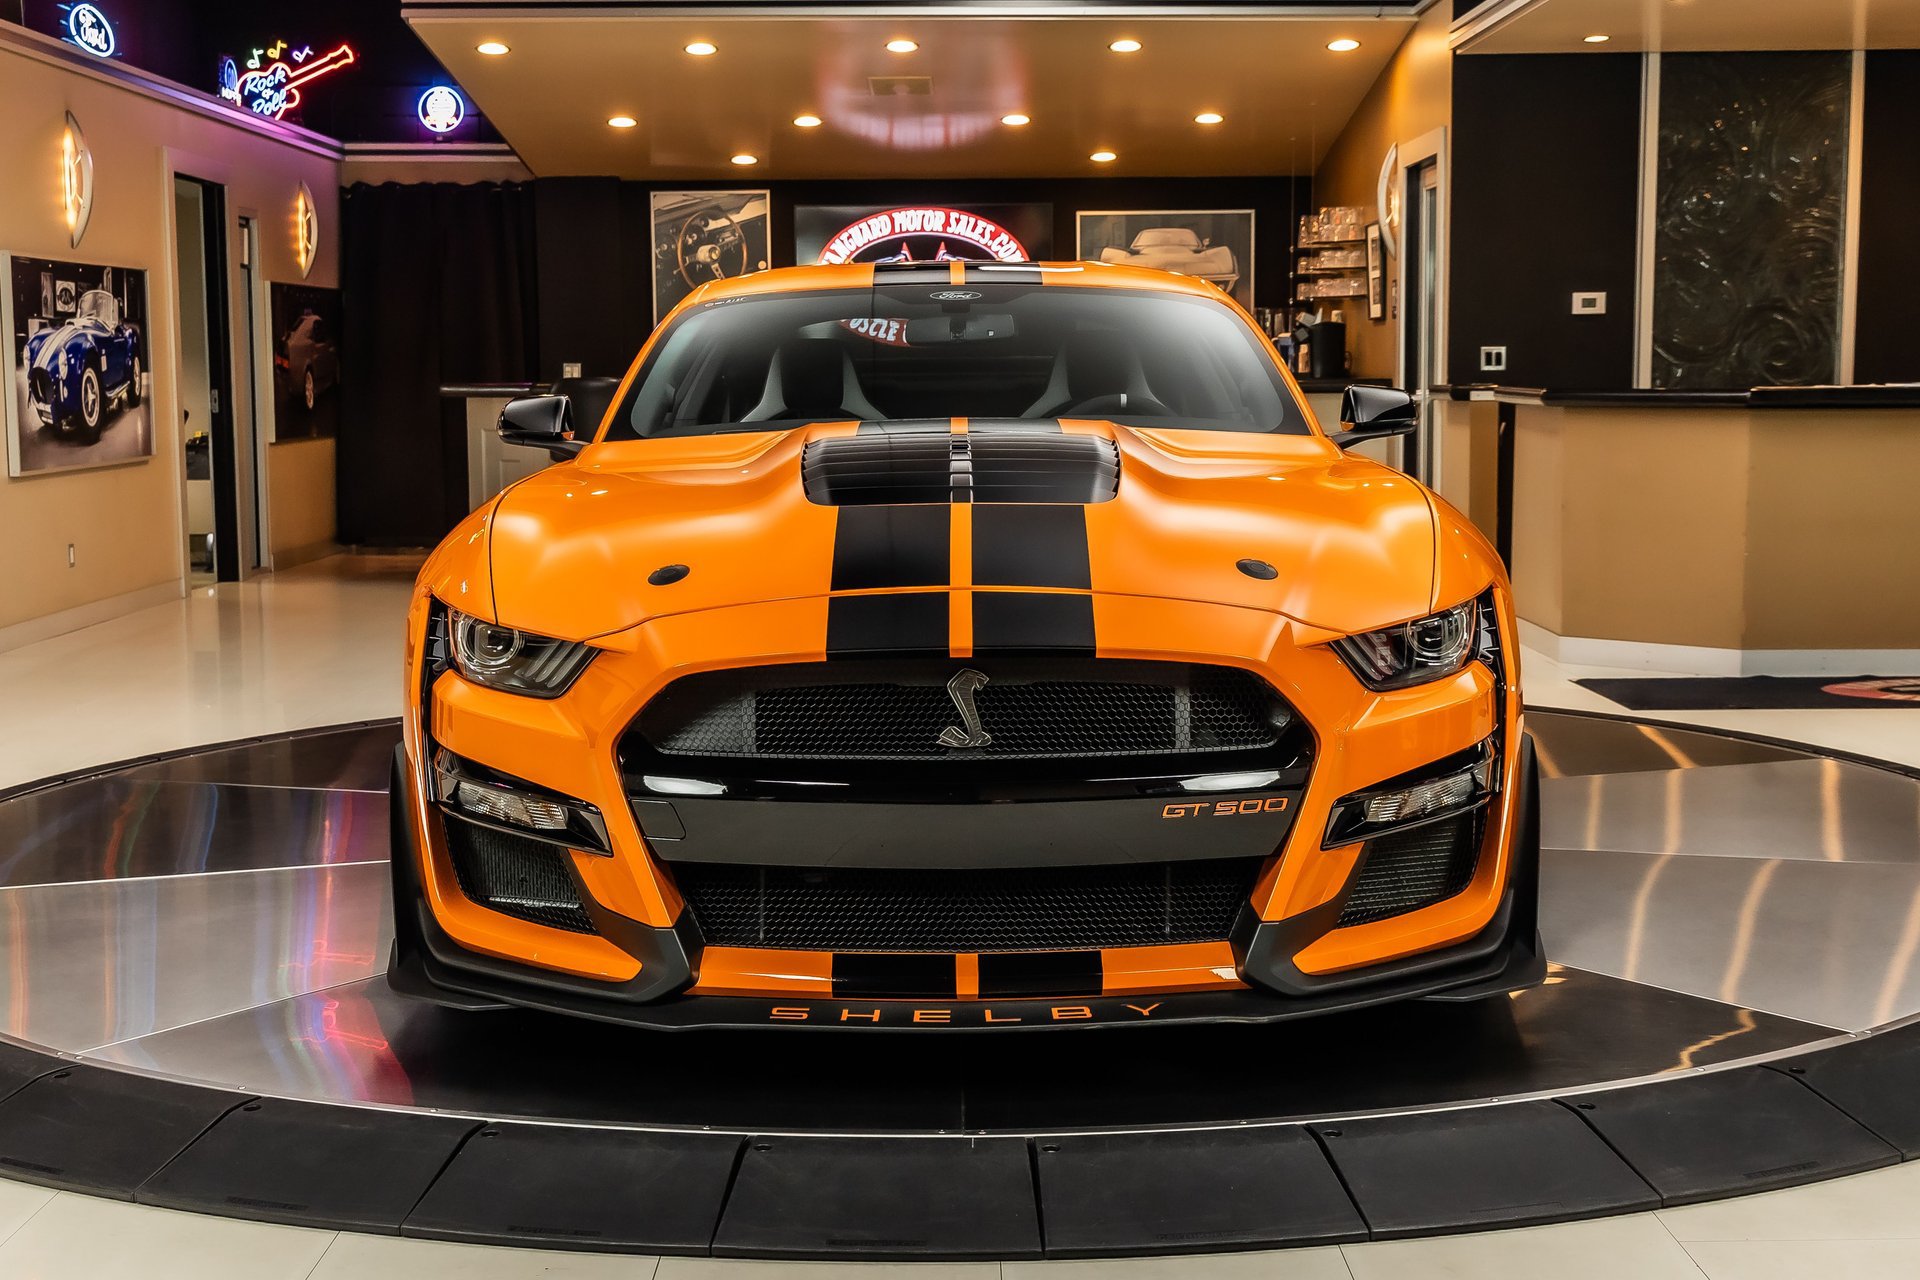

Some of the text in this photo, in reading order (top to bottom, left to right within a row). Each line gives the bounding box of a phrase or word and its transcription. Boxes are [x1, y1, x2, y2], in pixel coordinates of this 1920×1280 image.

[244, 66, 286, 96] Rock
[821, 214, 892, 264] ANGUARD
[891, 209, 946, 234] MOTOR
[939, 291, 973, 300] Ford
[849, 318, 900, 341] USCLE
[769, 1002, 1162, 1023] SHELBY
